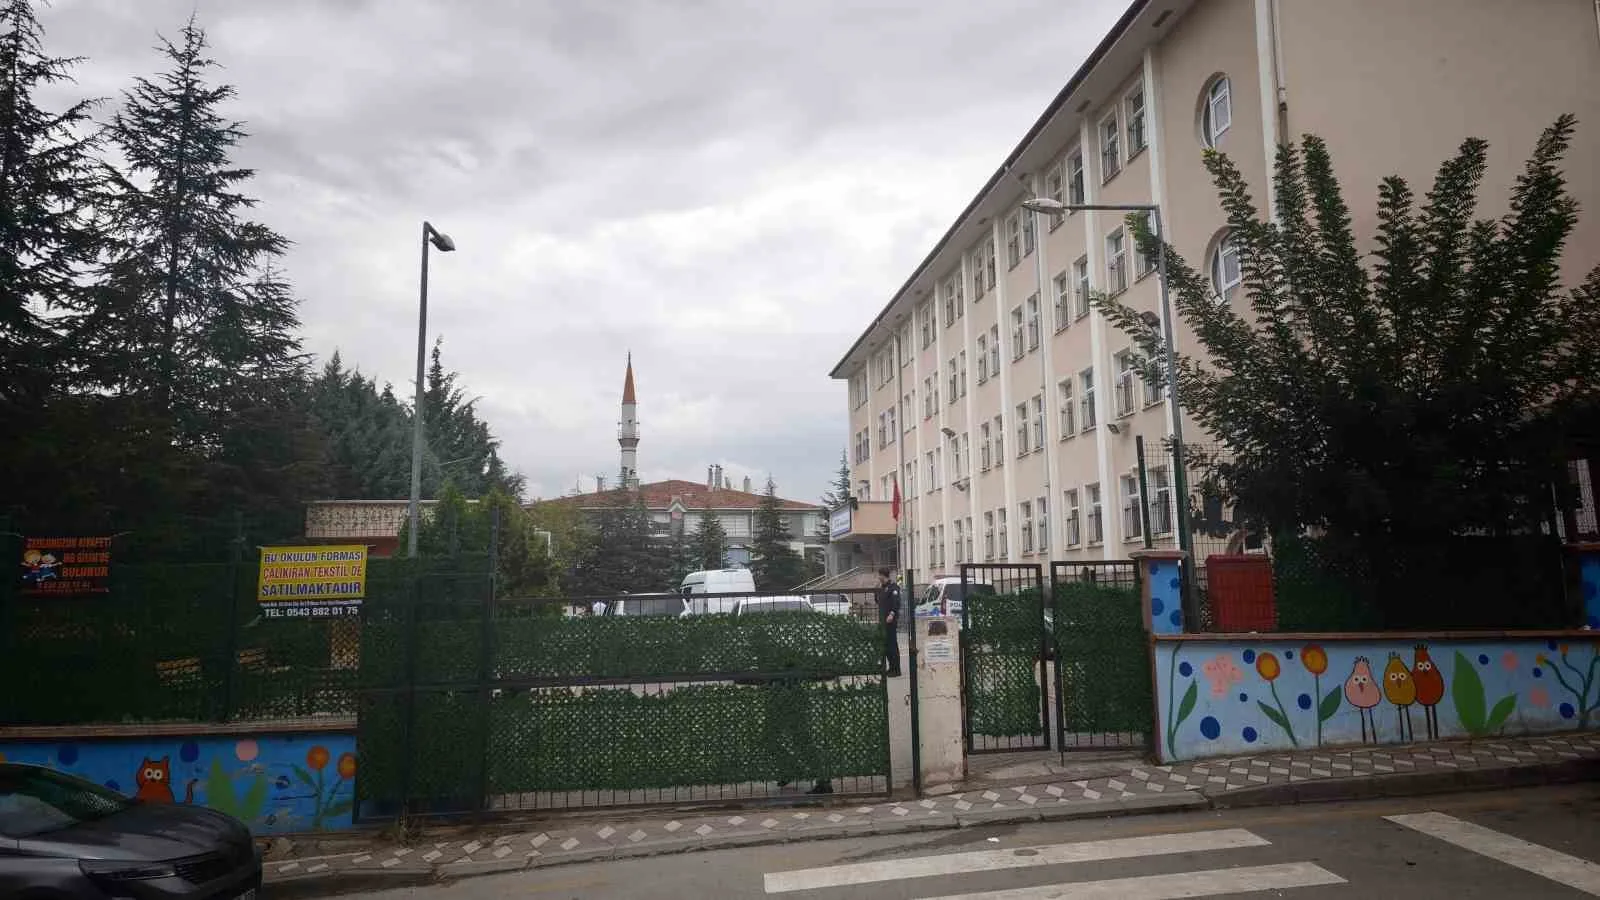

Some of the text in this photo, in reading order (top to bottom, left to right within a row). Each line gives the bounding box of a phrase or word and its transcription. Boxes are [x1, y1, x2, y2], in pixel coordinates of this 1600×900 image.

[264, 551, 364, 563] BU OKULUN FORMASI
[314, 563, 347, 577] TEKSTİL
[351, 565, 362, 577] DE
[262, 582, 361, 595] SATILMAKTADIR
[264, 608, 284, 617] TEL:
[287, 607, 309, 617] 0543
[332, 606, 343, 615] 01
[347, 606, 358, 615] 75
